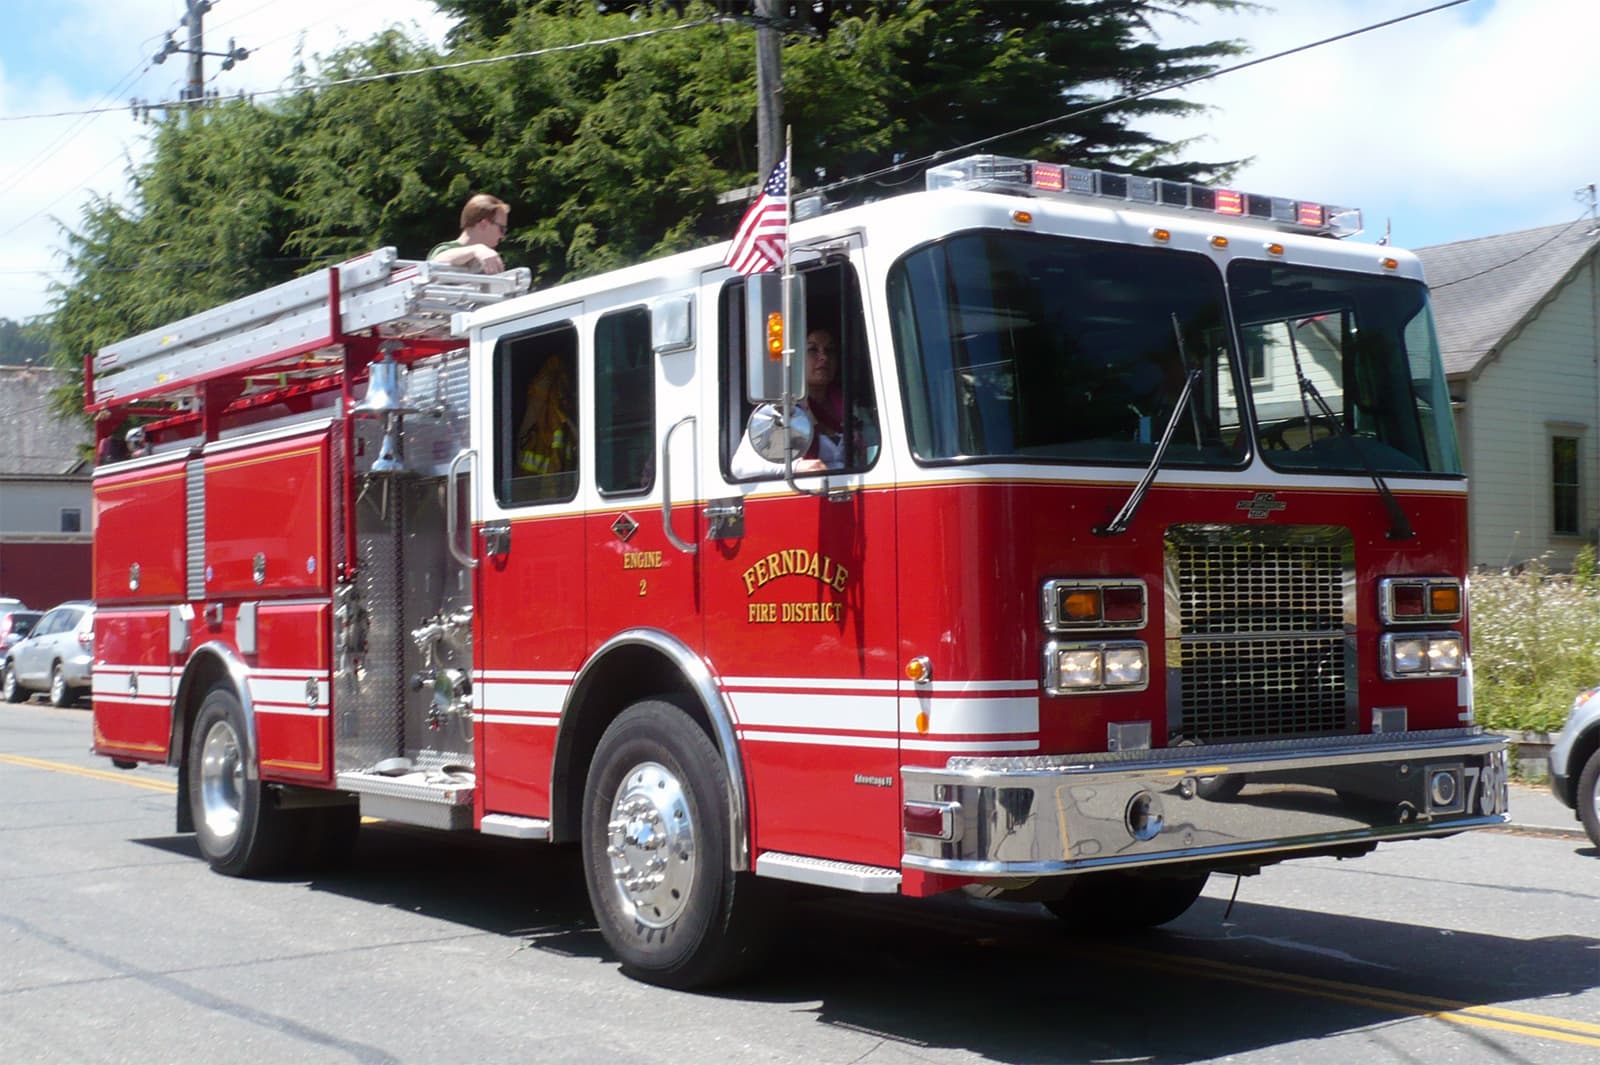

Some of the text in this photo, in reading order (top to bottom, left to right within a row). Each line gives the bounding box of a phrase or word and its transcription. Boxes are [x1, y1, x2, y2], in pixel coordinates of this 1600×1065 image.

[623, 551, 663, 569] ENGINE
[742, 549, 849, 595] FERNDALE
[639, 578, 647, 596] 2
[748, 602, 842, 622] FIRE DISTRICT
